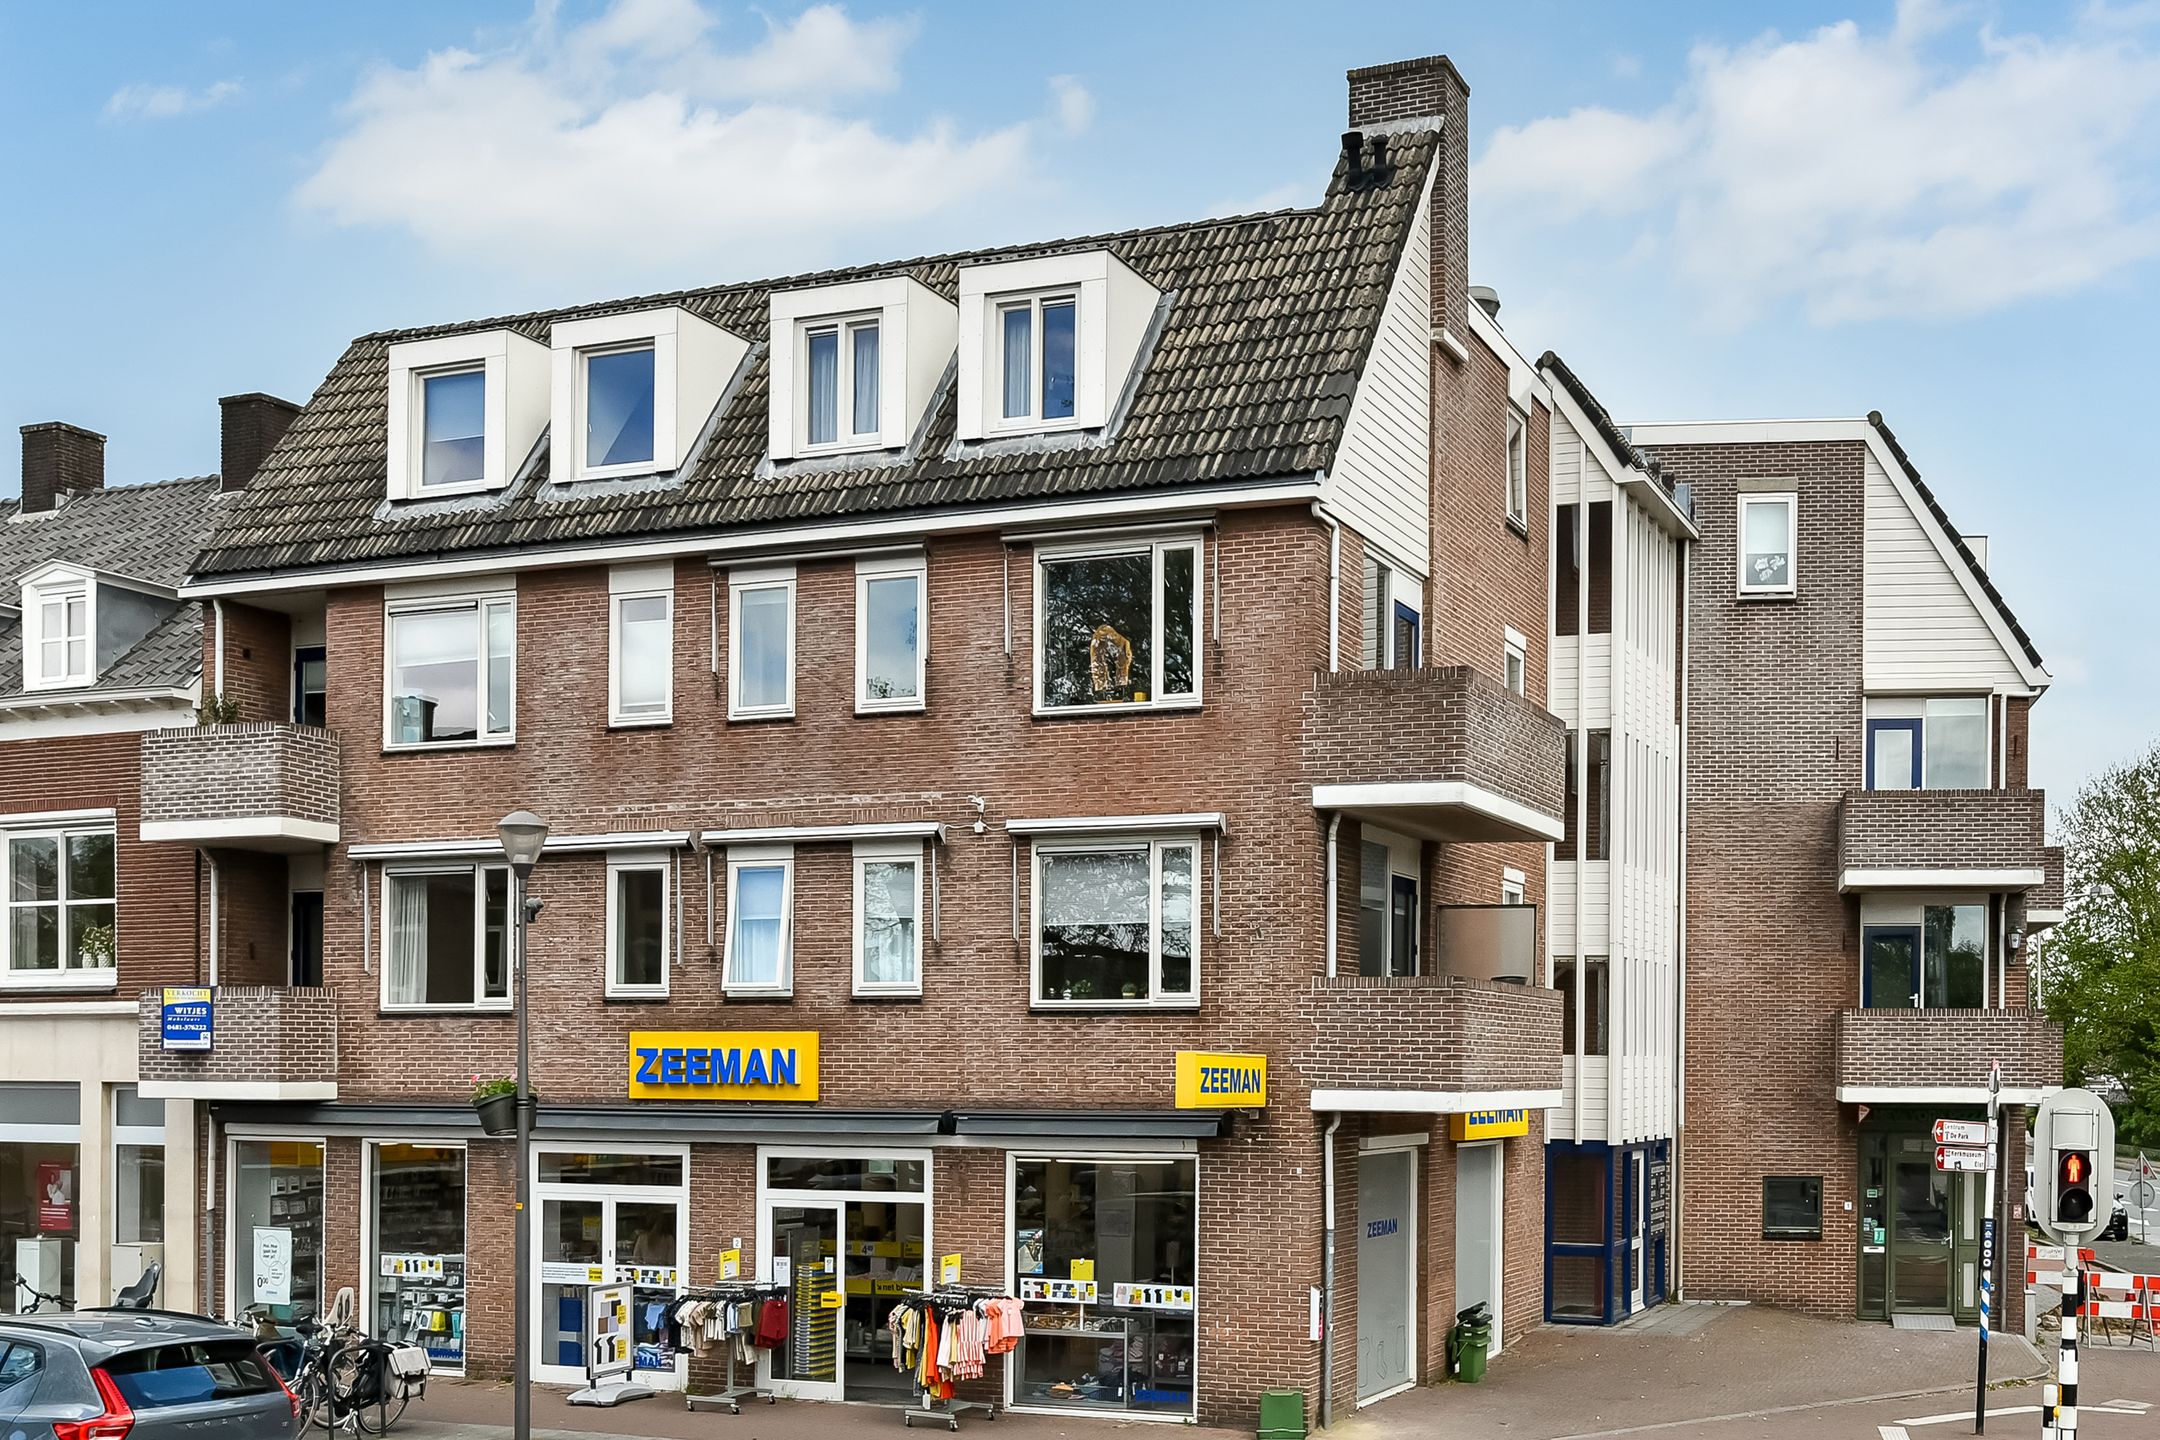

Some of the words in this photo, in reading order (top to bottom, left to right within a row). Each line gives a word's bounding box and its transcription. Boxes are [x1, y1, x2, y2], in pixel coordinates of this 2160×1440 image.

[174, 1007, 207, 1015] WITJES
[636, 1047, 798, 1086] ZEEMAN
[1200, 1067, 1261, 1094] ZEEMAN
[1367, 1218, 1398, 1238] ZEEMAN
[186, 1415, 259, 1428] VOLVO
